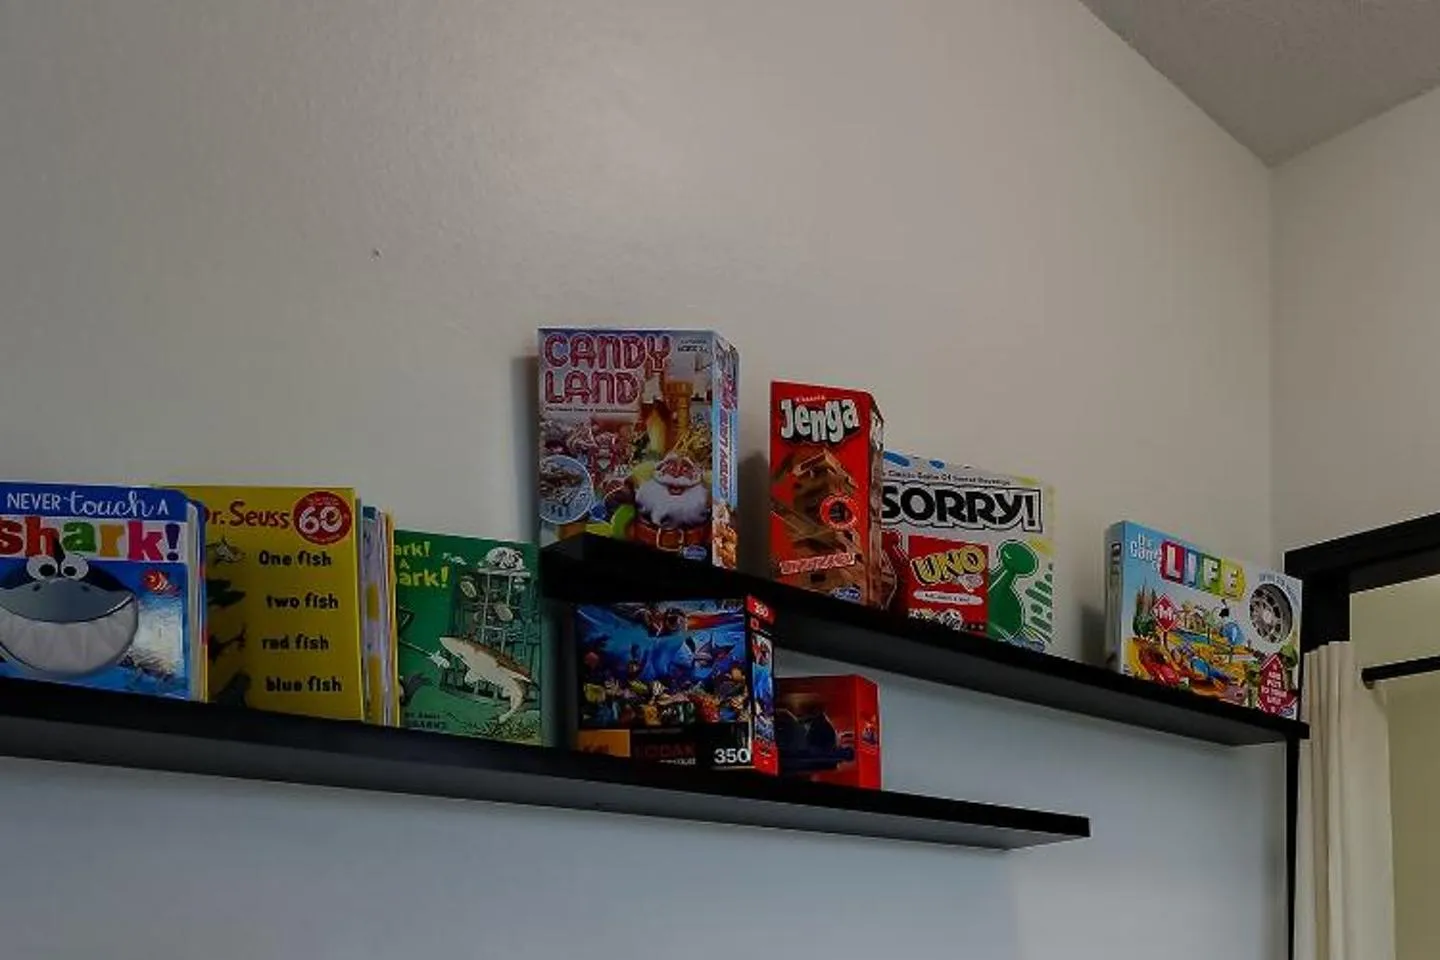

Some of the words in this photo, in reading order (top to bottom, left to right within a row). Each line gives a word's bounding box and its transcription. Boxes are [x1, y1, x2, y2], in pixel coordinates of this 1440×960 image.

[545, 333, 672, 370] CANDY
[545, 370, 639, 404] LAND
[780, 399, 859, 443] Jenga
[7, 493, 60, 511] NEVER
[64, 491, 154, 517] touch
[158, 500, 170, 515] A
[229, 501, 290, 528] Seuss
[883, 486, 1037, 527] SORRY!
[0, 516, 181, 561] shark!
[394, 541, 431, 556] ark!
[259, 552, 293, 566] One
[297, 551, 332, 566] fish
[912, 546, 986, 585] UNO
[1165, 543, 1243, 599] LIFE
[266, 595, 300, 609] two
[305, 593, 339, 609] fish
[262, 636, 289, 650] red
[296, 633, 330, 650] fish
[266, 676, 303, 692] blue
[308, 676, 343, 692] fish
[714, 747, 751, 764] 350
